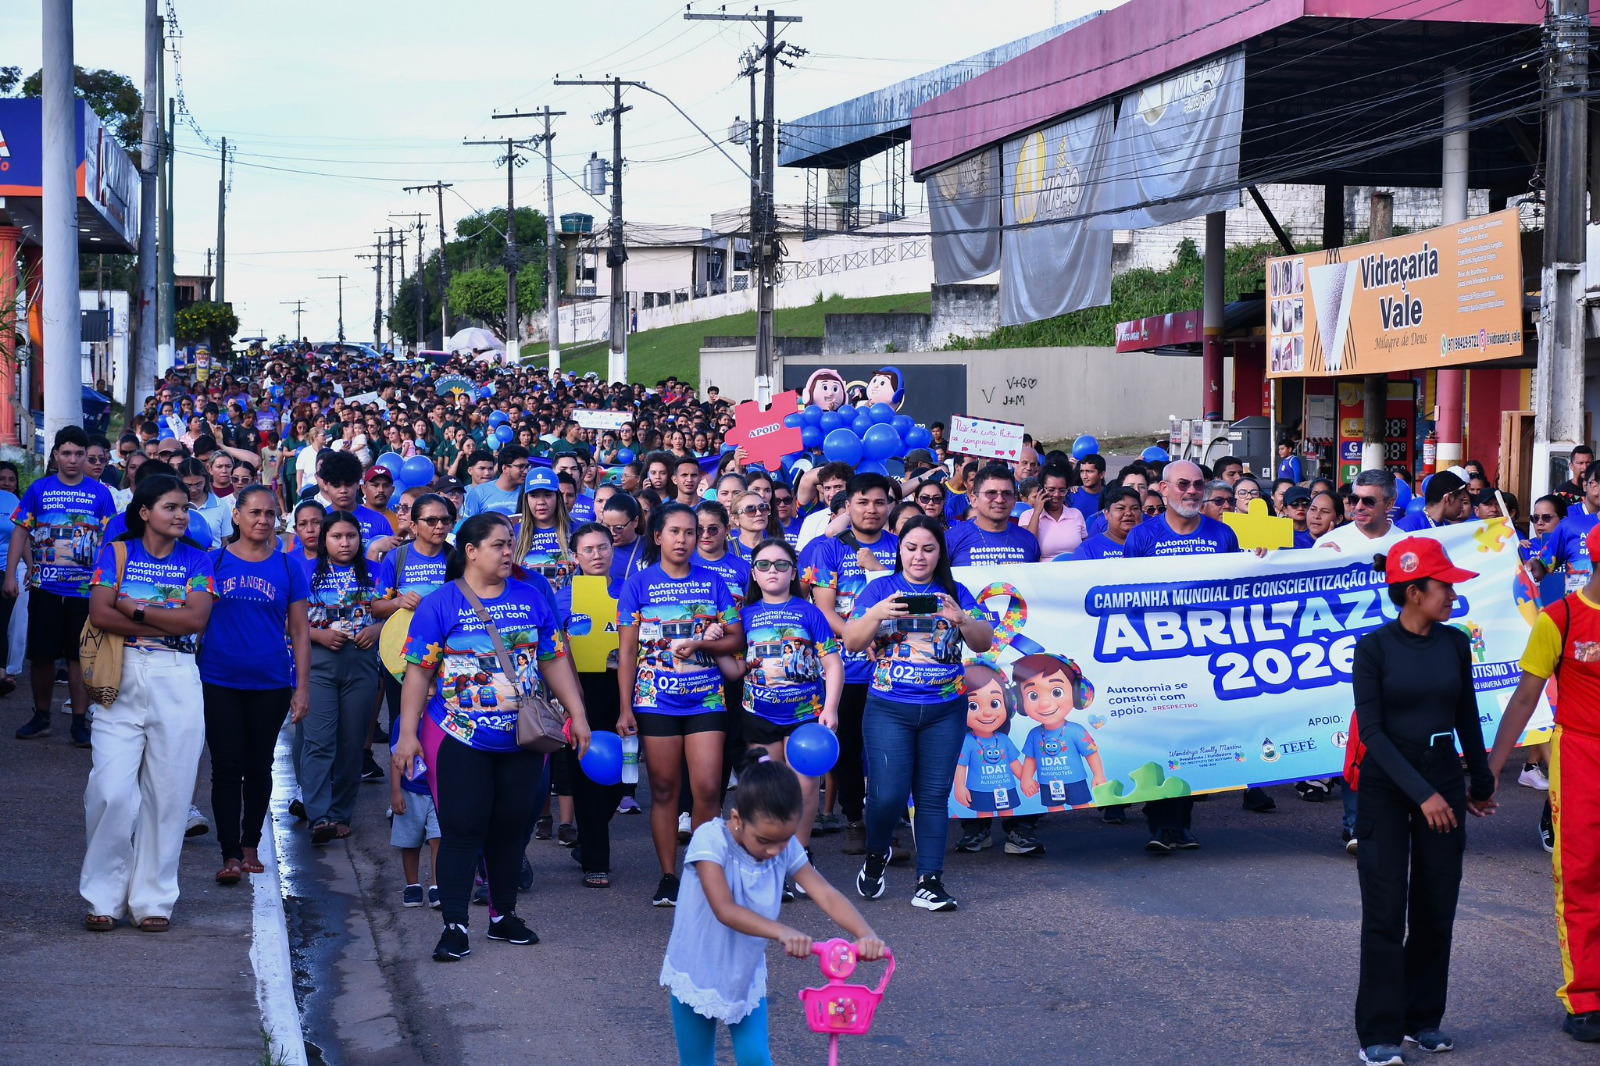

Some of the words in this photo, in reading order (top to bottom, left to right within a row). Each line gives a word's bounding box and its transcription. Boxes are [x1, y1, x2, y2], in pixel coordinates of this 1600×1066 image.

[1360, 242, 1438, 291] Vidraçaria
[1379, 293, 1423, 330] Vale
[1374, 333, 1400, 354] Milagre
[1401, 332, 1409, 346] de
[1411, 331, 1428, 346] Deus
[1349, 419, 1358, 430] G
[749, 423, 780, 438] APOIO
[1349, 441, 1358, 452] G
[1349, 465, 1358, 475] D
[43, 502, 66, 510] apoio.
[76, 497, 93, 505] com
[1155, 537, 1206, 549] Autonomia
[1155, 544, 1193, 555] constrói
[1196, 545, 1215, 553] com
[970, 552, 1006, 560] constrói
[128, 560, 178, 571] Autonomia
[43, 567, 58, 578] 02
[127, 567, 163, 577] constrói
[405, 568, 437, 577] constrói
[126, 574, 154, 583] apoio.
[406, 575, 430, 584] apoio.
[223, 576, 237, 595] LOS
[240, 574, 276, 601] ANGELES
[648, 580, 700, 591] Autonomia
[1094, 588, 1169, 609] CAMPANHA
[1172, 585, 1231, 605] MUNDIAL
[1233, 583, 1250, 600] DE
[1252, 569, 1367, 598] CONSCIENTIZAÇÃO
[649, 587, 688, 597] constrói
[650, 595, 679, 604] apoio.
[458, 602, 517, 617] Autnomia
[518, 603, 531, 612] se
[753, 610, 793, 619] Autonomia
[506, 611, 529, 620] com
[751, 619, 773, 628] apoio.
[1101, 603, 1290, 655] ABRIL
[1216, 635, 1355, 691] 2026
[893, 665, 914, 679] 02
[658, 676, 679, 690] 02
[926, 676, 954, 685] Autismo
[1480, 679, 1502, 689] HAVERÁ
[690, 684, 715, 694] Autismo
[1107, 683, 1172, 694] Autonomia
[1174, 681, 1188, 690] se
[782, 696, 807, 704] Autismo
[1108, 693, 1157, 705] constrói
[1159, 692, 1186, 701] com
[1110, 704, 1148, 719] apoio.
[1152, 702, 1198, 711] #RESPECTRO
[1307, 714, 1345, 727] APOIO:
[1279, 736, 1317, 754] TEFÉ
[1041, 756, 1068, 766] IDAT
[981, 764, 1007, 775] IDAT
